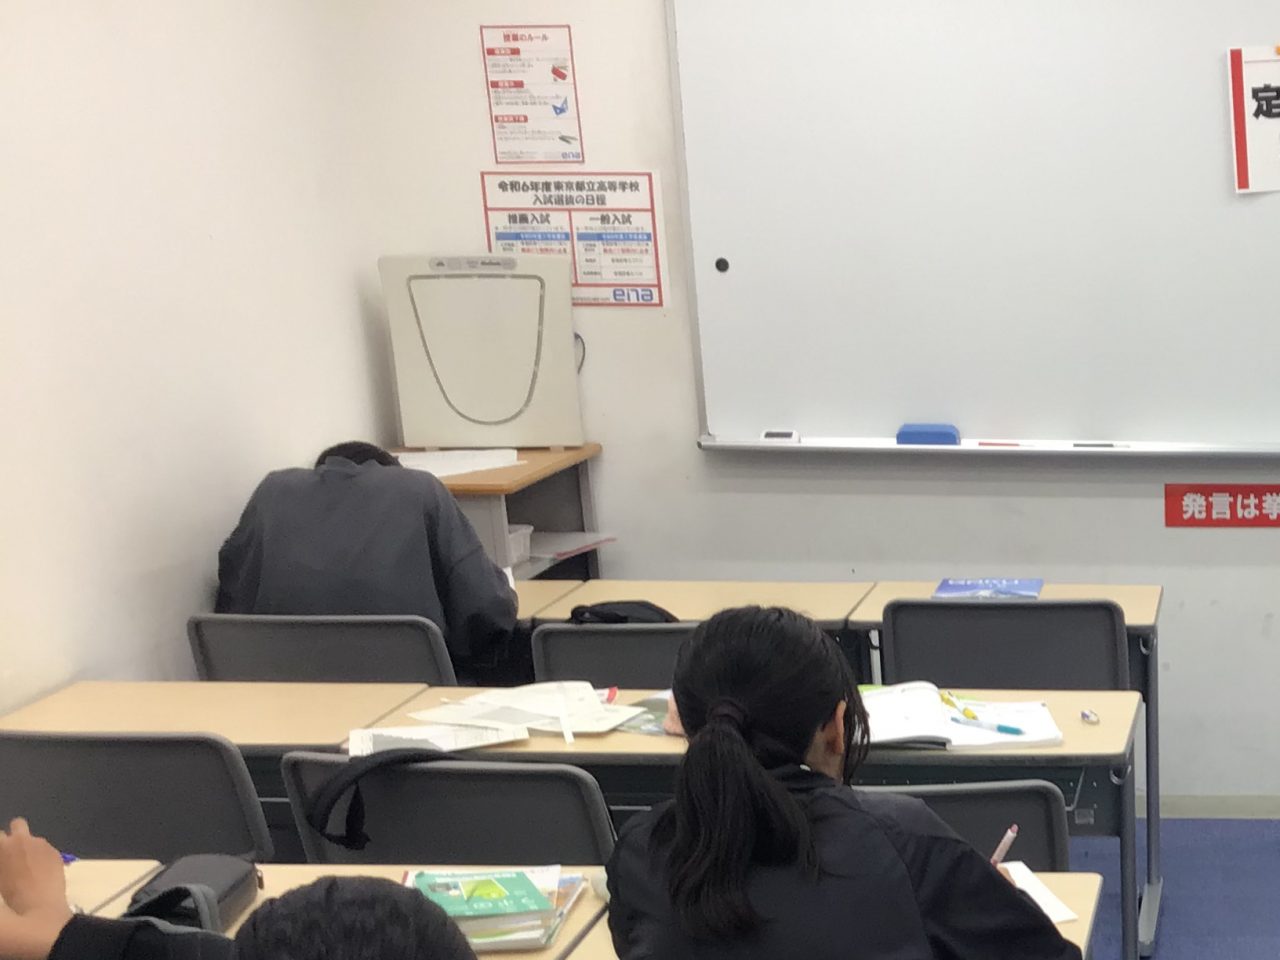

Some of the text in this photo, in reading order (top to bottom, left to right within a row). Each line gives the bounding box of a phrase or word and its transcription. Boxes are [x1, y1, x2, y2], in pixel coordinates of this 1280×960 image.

[589, 213, 632, 225] 一般入試
[612, 288, 654, 302] ena
